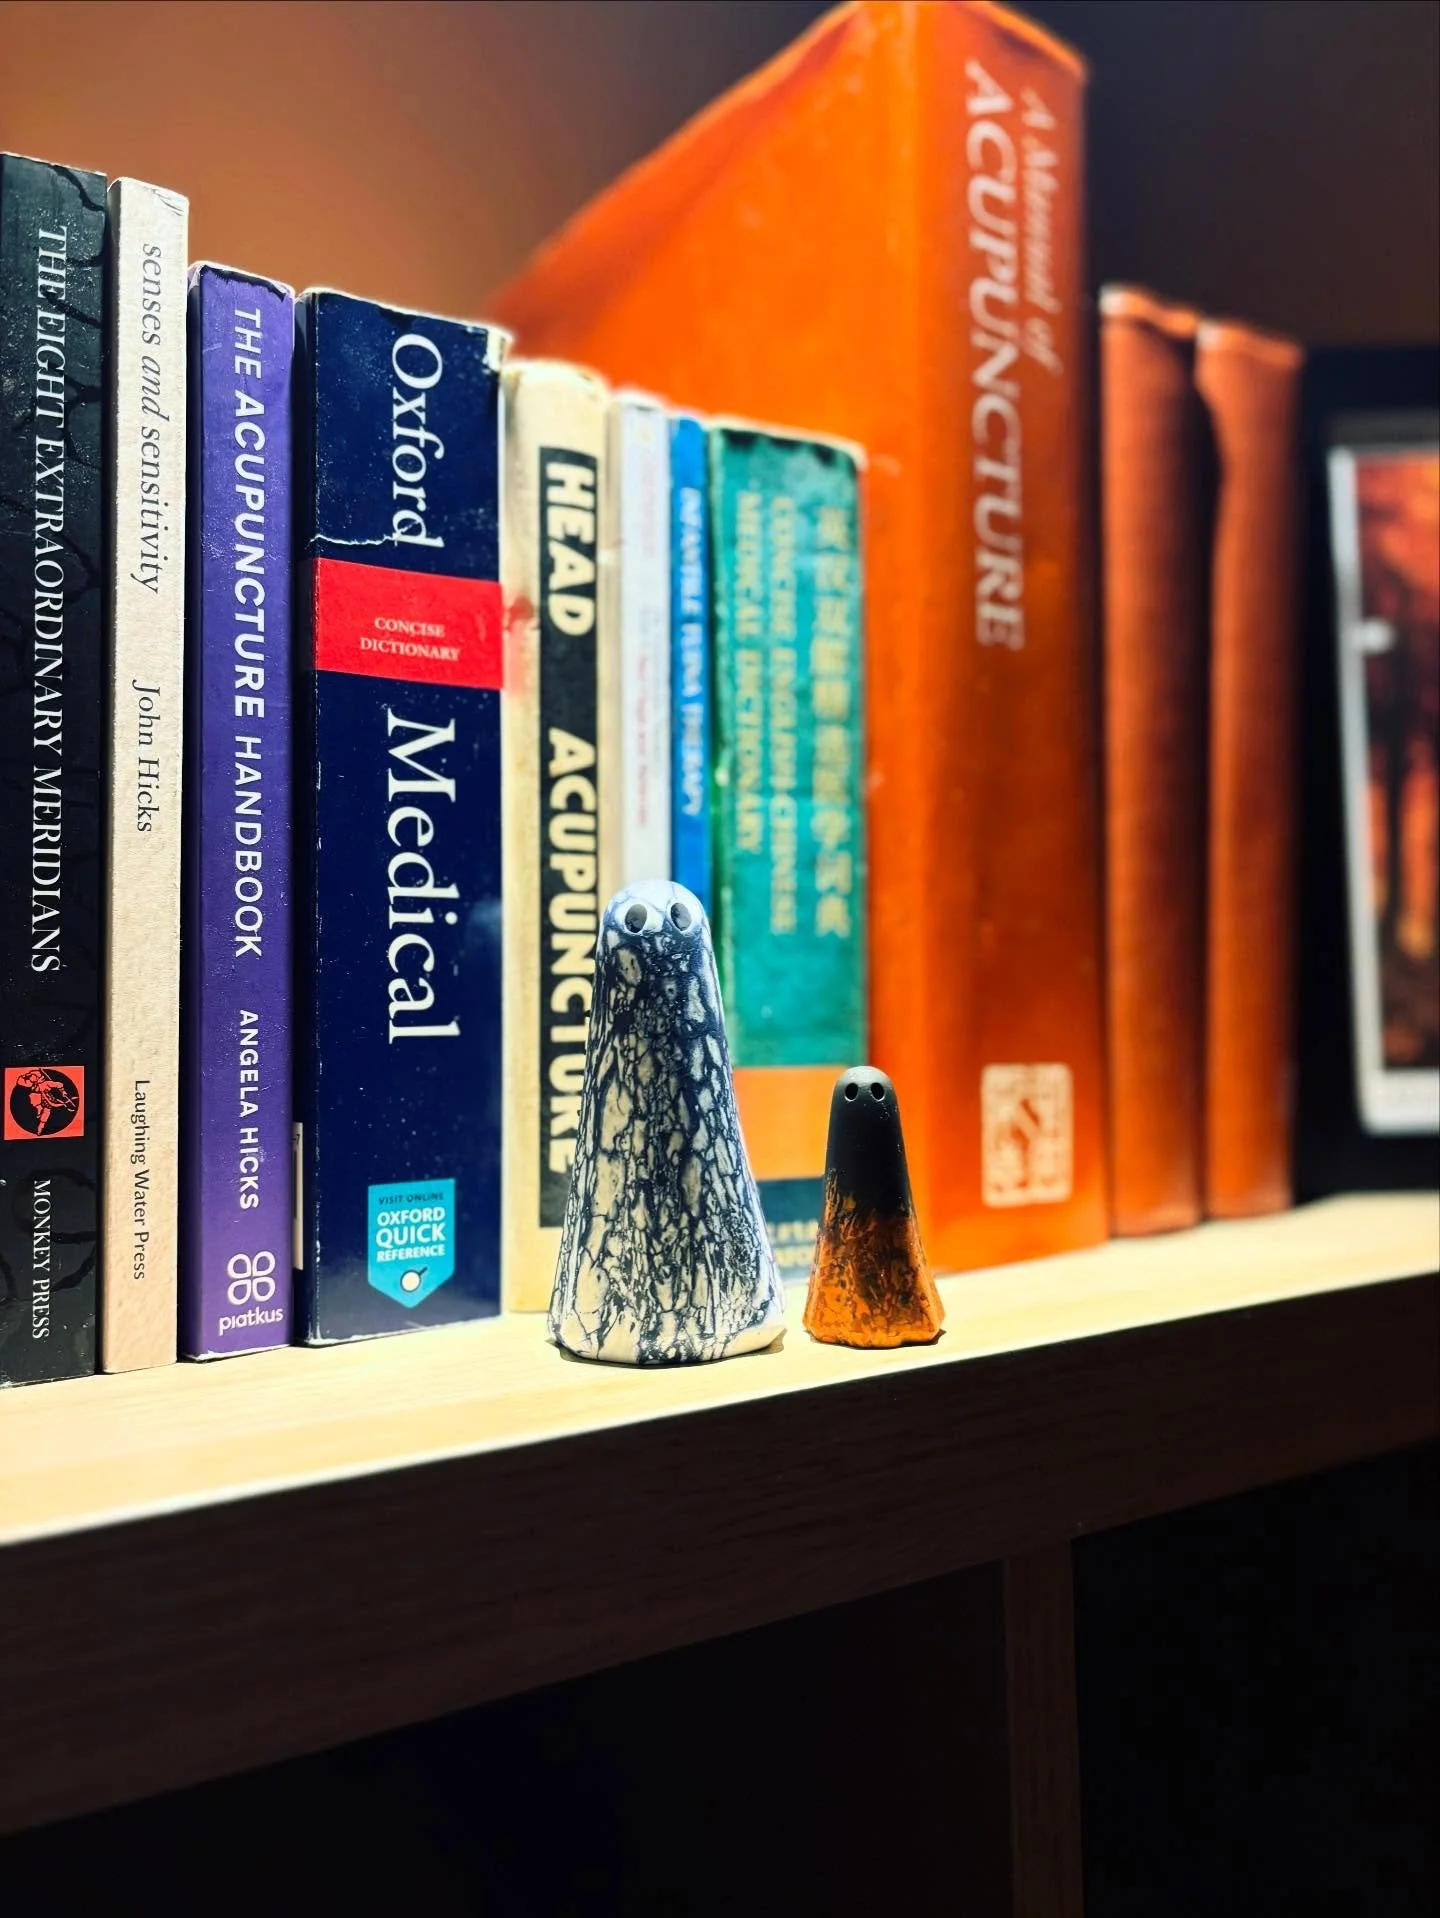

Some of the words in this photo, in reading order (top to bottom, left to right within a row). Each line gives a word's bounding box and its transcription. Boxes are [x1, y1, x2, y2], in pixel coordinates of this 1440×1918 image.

[1020, 86, 1058, 131] A
[37, 226, 67, 300] THE
[141, 242, 162, 347] senses
[36, 308, 66, 429] EIGHT
[234, 307, 263, 379] THE
[966, 58, 1026, 651] ACUPUNCTURE
[1020, 316, 1063, 375] of
[140, 355, 170, 424] and
[391, 333, 445, 549] Oxford
[130, 424, 163, 594] sensitivity
[545, 460, 596, 637] HEAD
[33, 435, 65, 755] EXTRAORDINARY
[234, 389, 266, 719] ACUPUNCTURE
[735, 491, 763, 640] MEDICAL
[770, 495, 797, 638] CONCISE
[359, 636, 461, 662] DICTIONARY
[373, 616, 446, 639] CONCISE
[131, 679, 161, 746] John
[735, 648, 763, 853] DICTIONARY
[136, 756, 160, 833] Hicks
[31, 766, 62, 973] MERIDIANS
[234, 733, 264, 958] HANDBOOK
[386, 707, 461, 1045] Medical
[239, 1008, 259, 1118] ANGELA
[130, 1080, 150, 1165] Laughing
[134, 1168, 150, 1226] Water
[239, 1127, 260, 1210] HICKS
[378, 1194, 404, 1205] VISIT
[406, 1191, 444, 1203] ONLINE
[32, 1179, 51, 1273] MONKEY
[133, 1231, 150, 1280] Press
[375, 1222, 446, 1249] QUICK
[376, 1244, 446, 1263] REFERENCE
[377, 1206, 446, 1227] OXFORD
[32, 1277, 50, 1340] PRESS
[219, 1306, 284, 1336] piatkus
